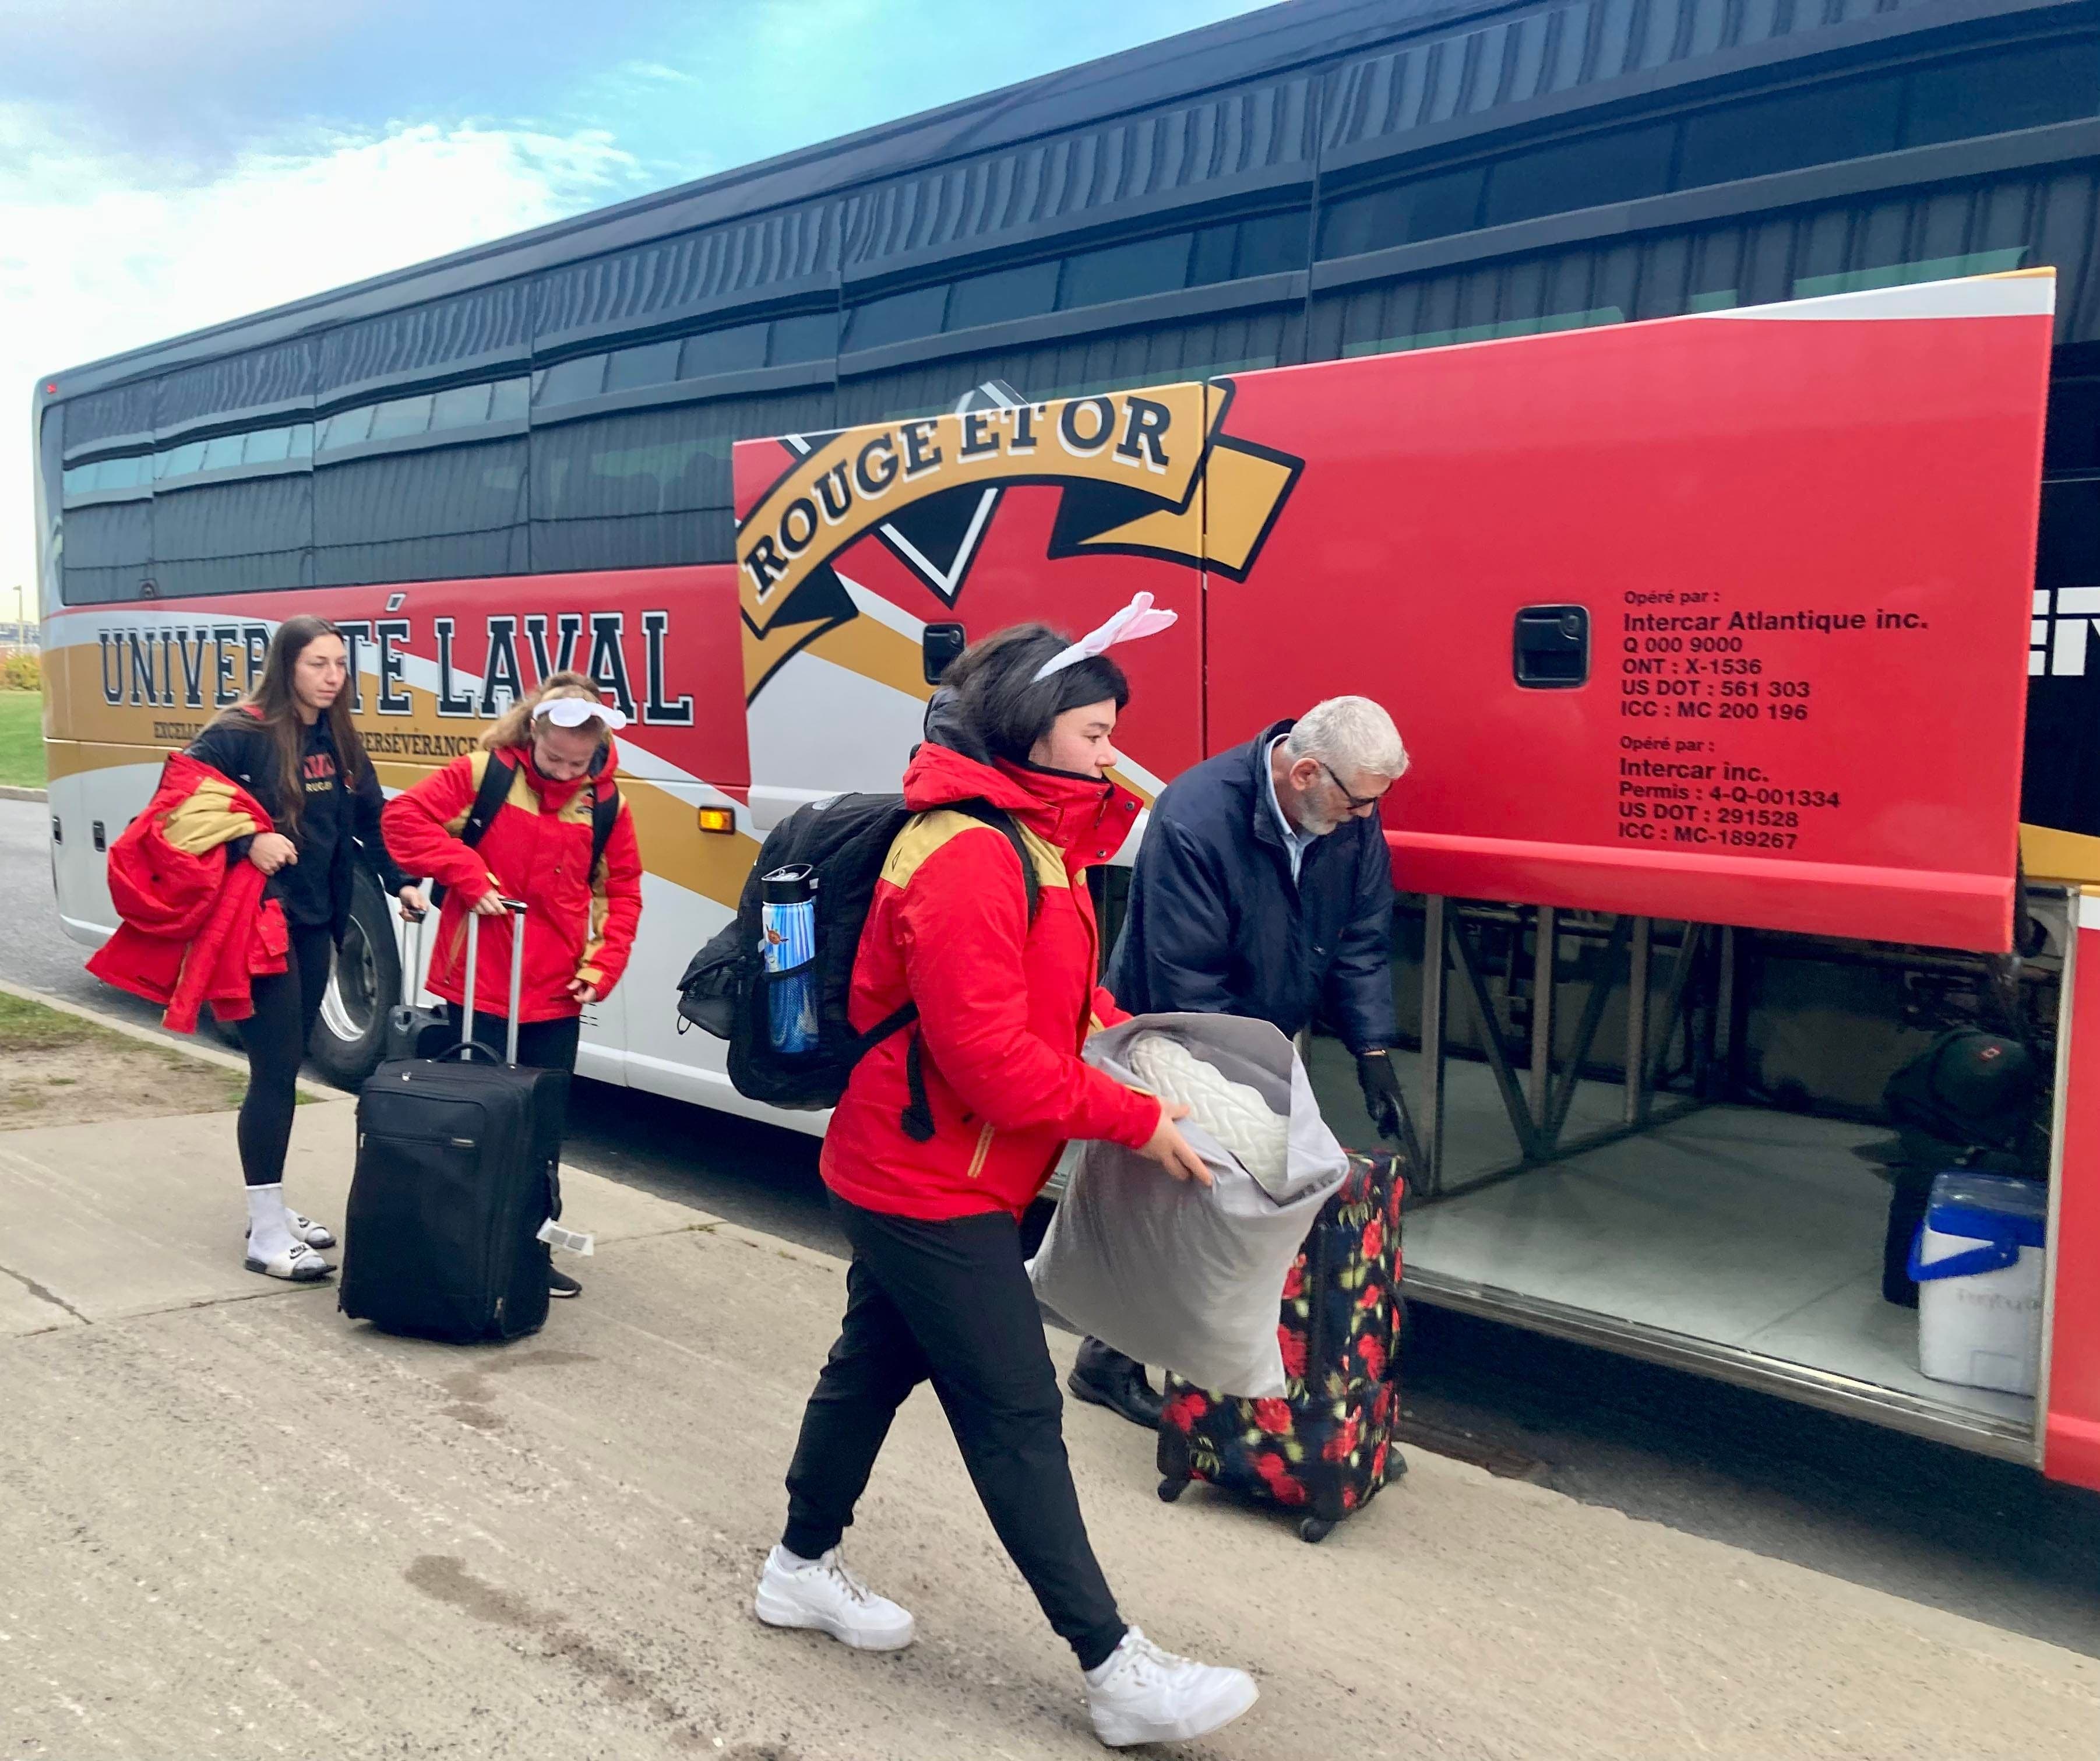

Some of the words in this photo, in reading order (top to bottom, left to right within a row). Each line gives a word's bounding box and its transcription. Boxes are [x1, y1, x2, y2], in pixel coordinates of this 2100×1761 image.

[741, 421, 942, 605] ROUGE
[957, 405, 1046, 464] ET
[1057, 396, 1171, 475] OR
[1625, 590, 1675, 606] Opéré
[1680, 593, 1708, 605] par
[1625, 613, 1721, 631] Intercar
[1728, 610, 1866, 634] Atlantique
[1876, 609, 1928, 629] inc.
[1623, 637, 1638, 653] Q
[1646, 637, 1682, 653] 000
[1690, 637, 1742, 652] 9000
[98, 593, 413, 716] UNIVERTÉ
[434, 610, 693, 726] LAVAL
[1622, 658, 1665, 674] ONT
[1686, 658, 1762, 675] X-1536
[1622, 679, 1649, 695] US
[1656, 680, 1700, 695] DOT
[1721, 681, 1759, 697] 561
[1769, 681, 1810, 698] 303
[1621, 700, 1657, 716] ICC
[1678, 702, 1711, 718] MC
[1719, 703, 1759, 719] 200
[1768, 704, 1807, 720] 196
[1620, 736, 1670, 751] Opéré
[1675, 741, 1704, 753] par
[1620, 758, 1716, 779] Intercar
[1724, 760, 1768, 782] inc.
[1620, 781, 1689, 800] Permis
[1710, 786, 1840, 808] 4-Q-001334
[1619, 802, 1646, 818] US
[1654, 804, 1697, 820] DOT
[1718, 808, 1798, 827] 291528
[1619, 823, 1654, 839] ICC
[1674, 826, 1798, 849] MC-189267
